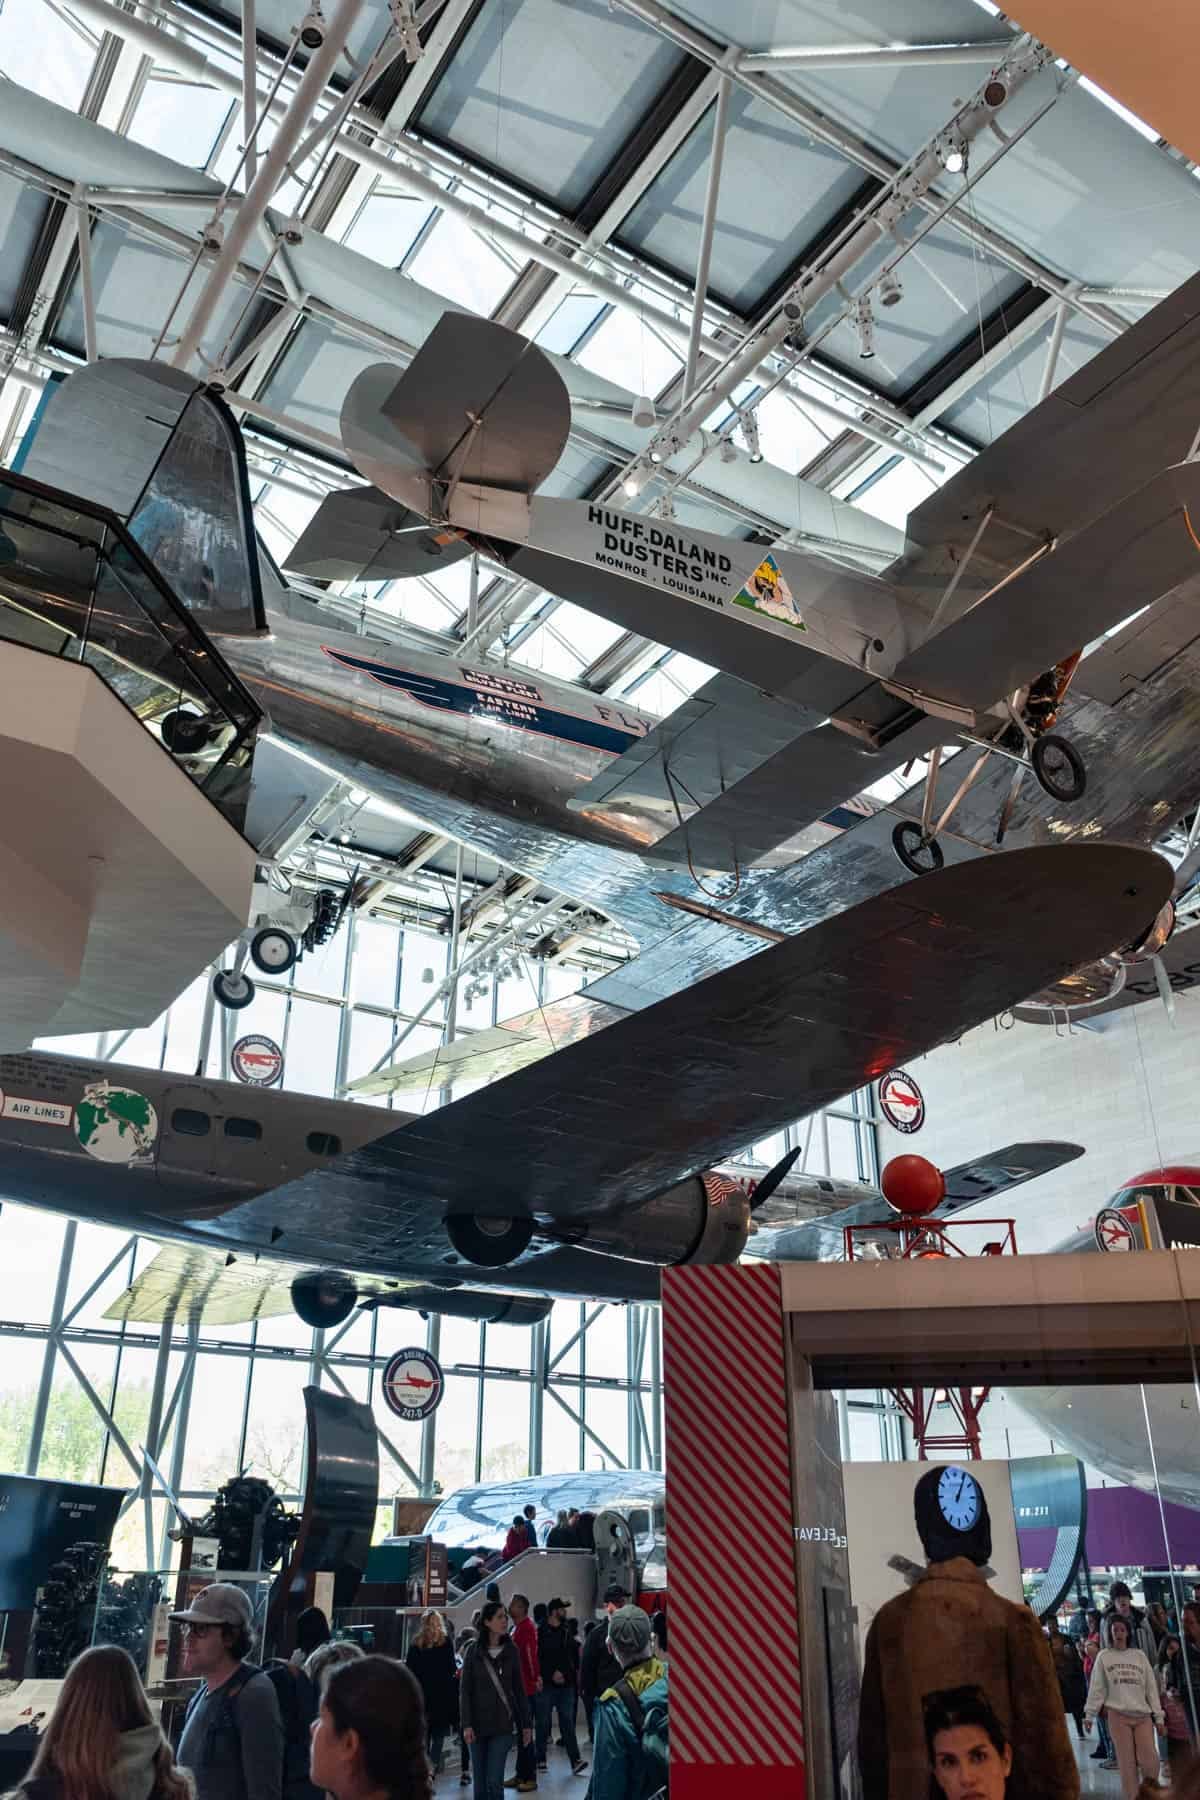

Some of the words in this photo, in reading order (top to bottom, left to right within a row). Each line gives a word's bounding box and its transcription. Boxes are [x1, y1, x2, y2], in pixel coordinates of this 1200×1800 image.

[604, 533, 703, 582] DUSTERS
[662, 576, 724, 607] LOUISIANA
[476, 692, 537, 715] EASTERN
[12, 1103, 31, 1113] AIR
[34, 1106, 65, 1119] LINES
